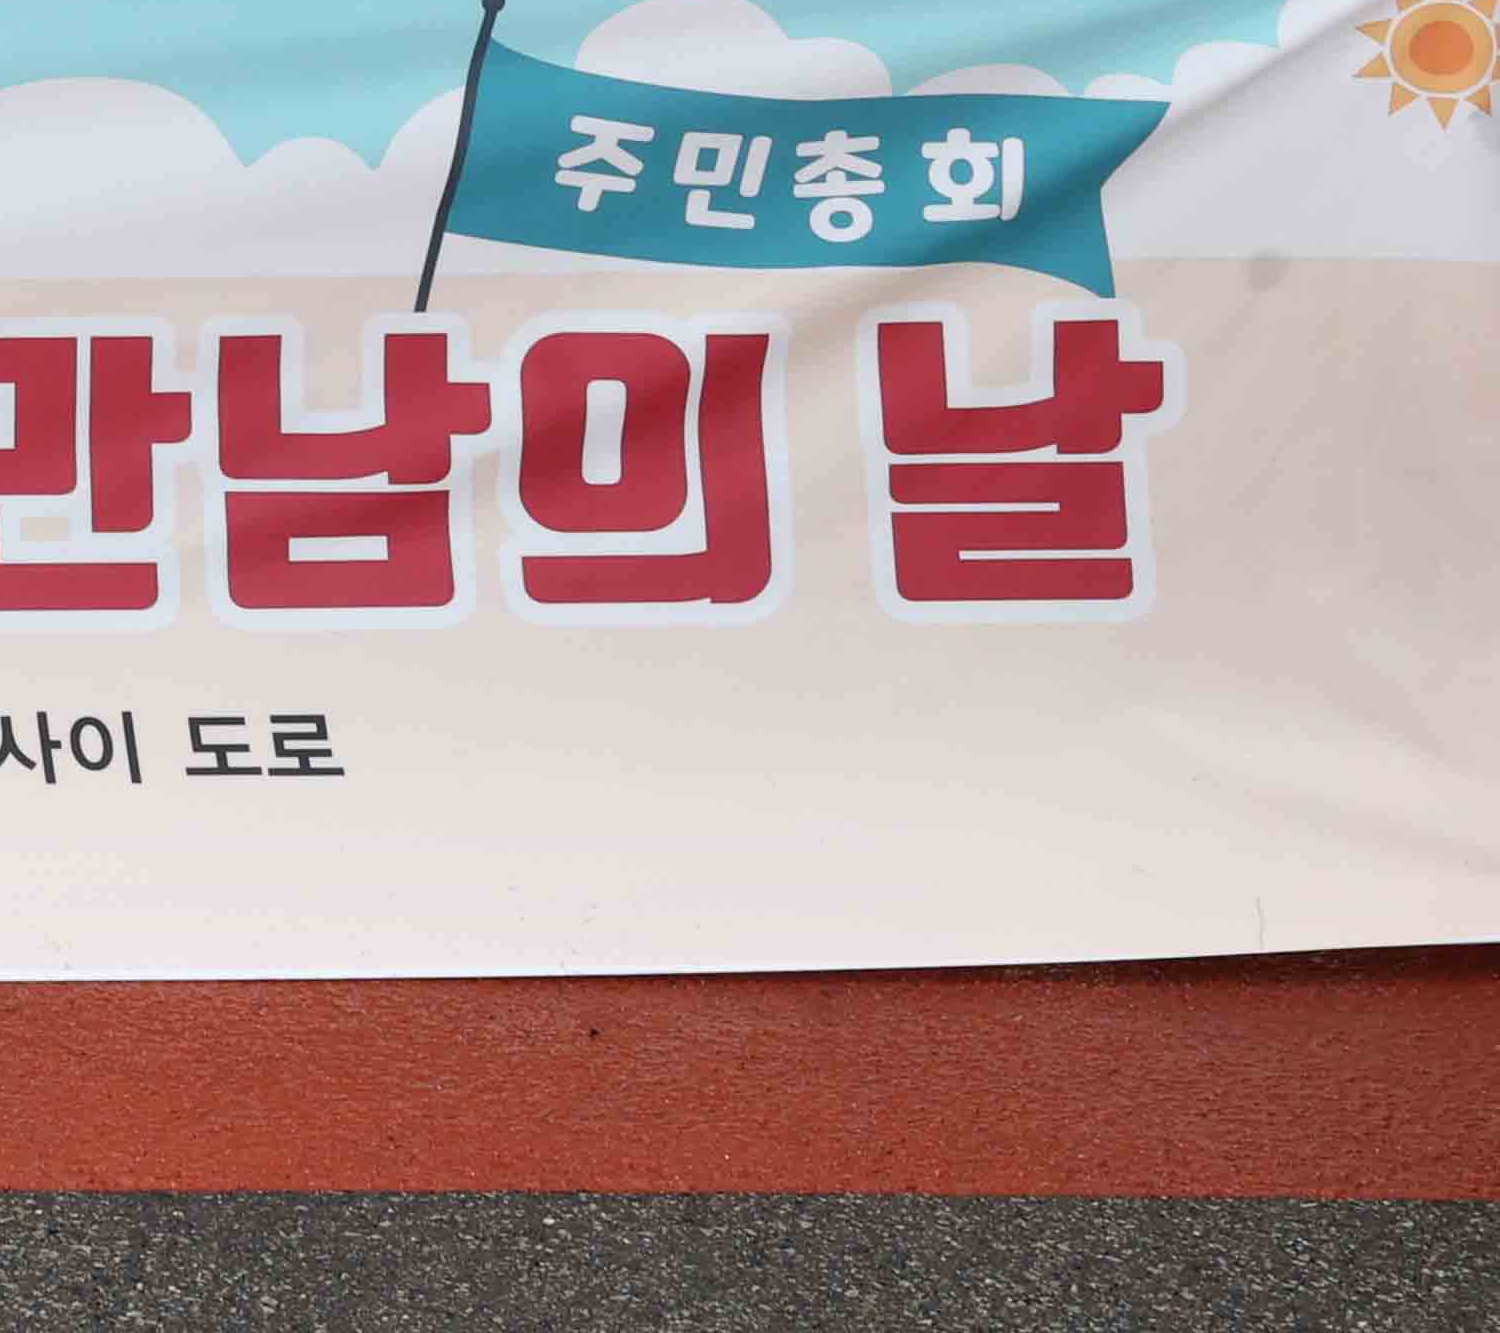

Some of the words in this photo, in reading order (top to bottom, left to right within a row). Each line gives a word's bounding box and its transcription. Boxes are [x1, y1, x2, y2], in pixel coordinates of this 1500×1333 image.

[554, 114, 1025, 243] 주민총회
[877, 318, 1165, 602] 날
[185, 714, 345, 778] 도로
